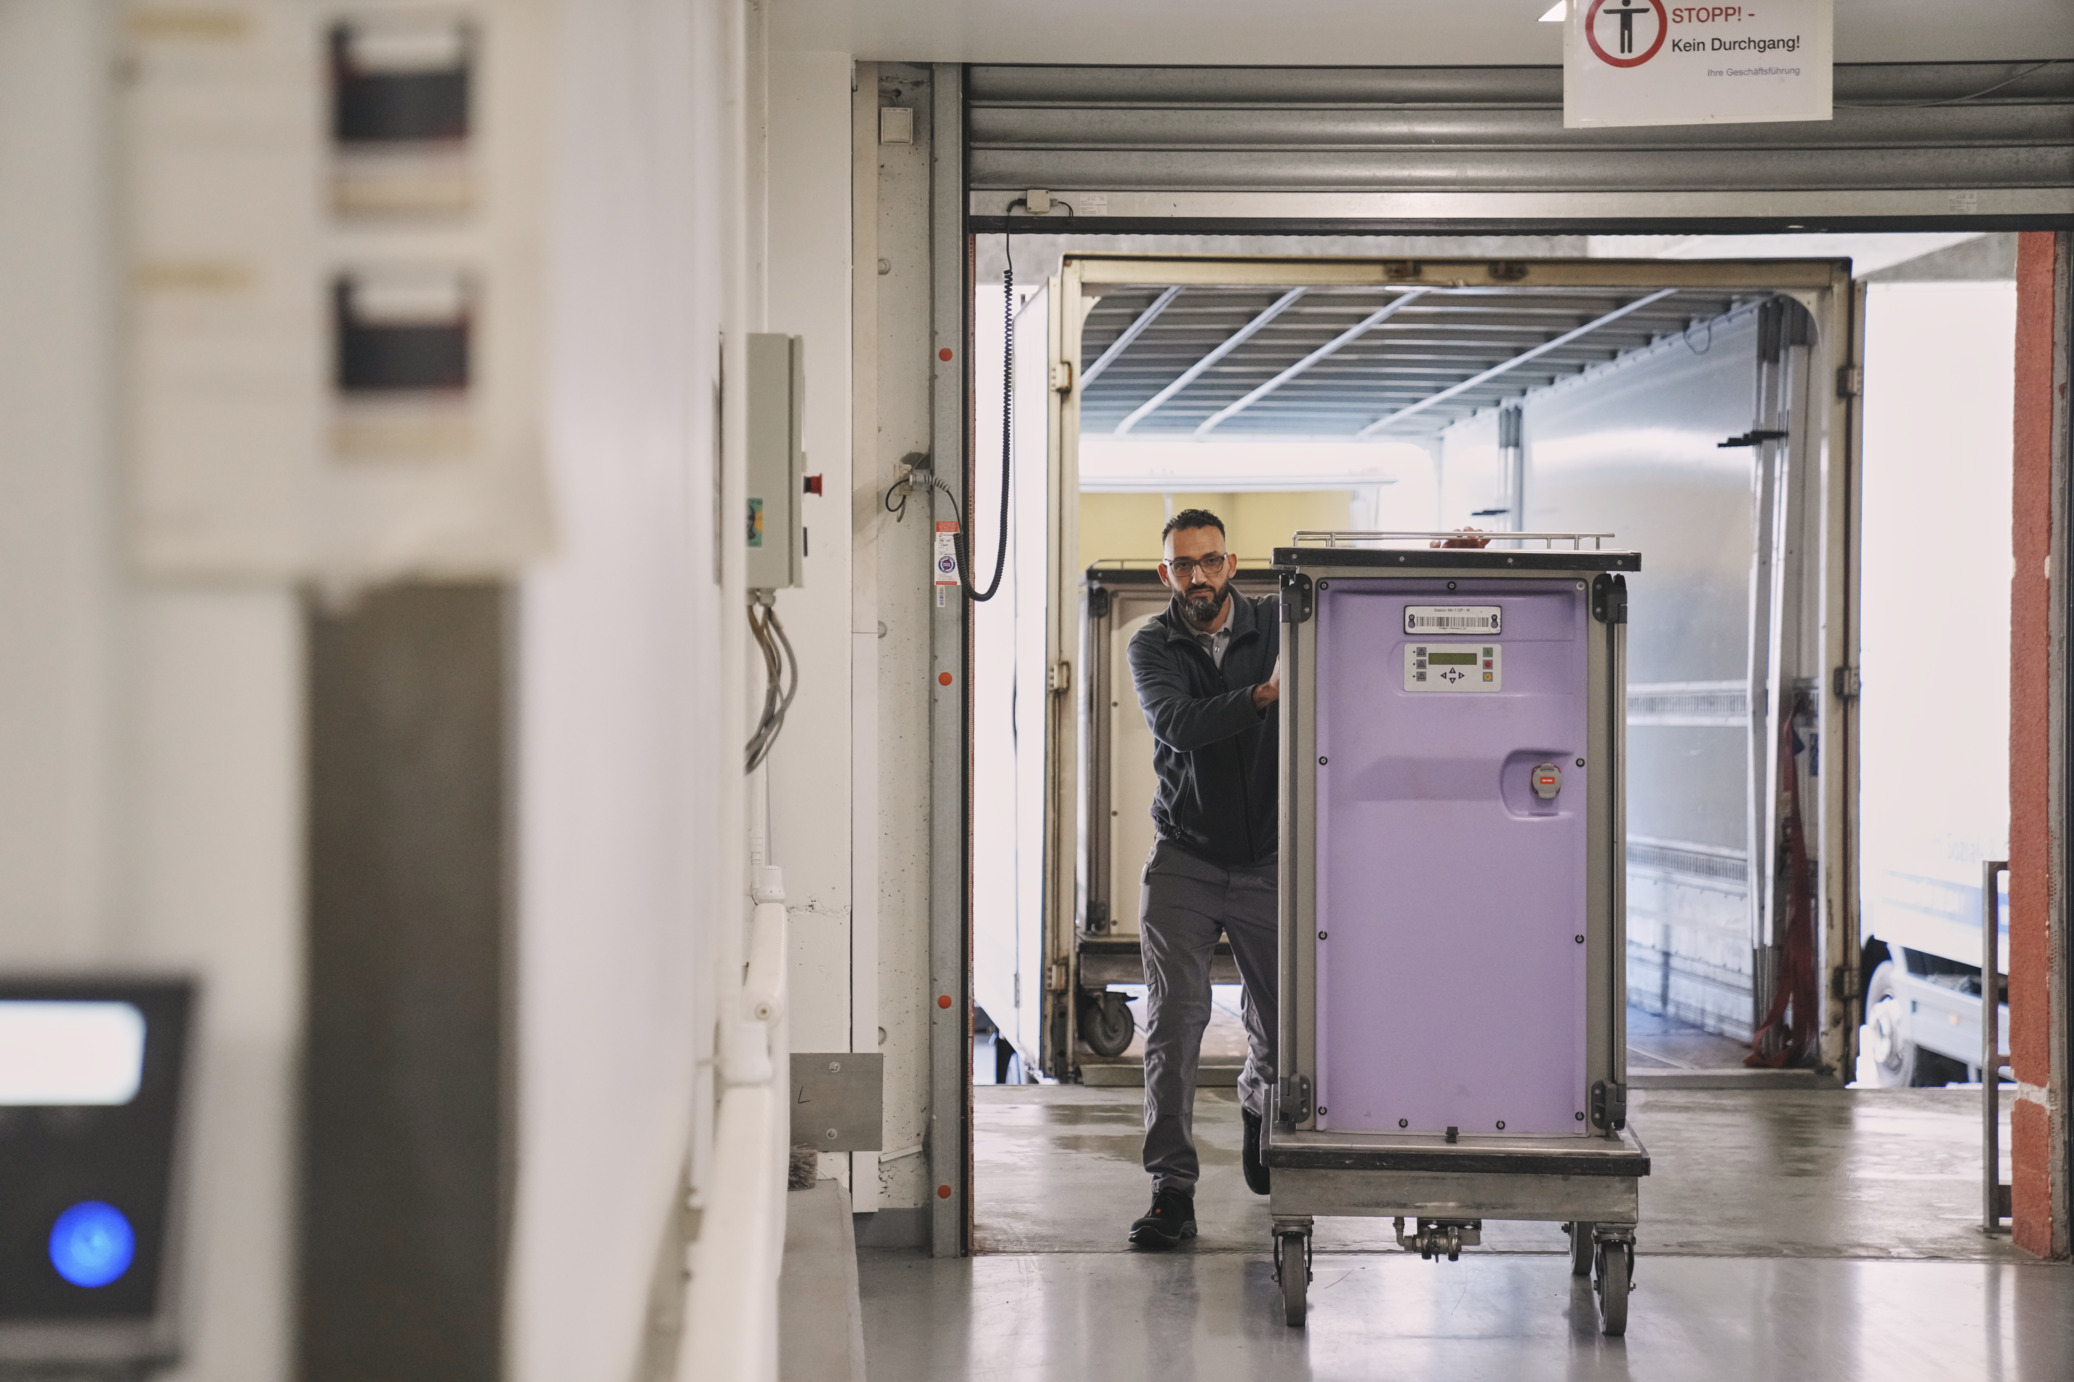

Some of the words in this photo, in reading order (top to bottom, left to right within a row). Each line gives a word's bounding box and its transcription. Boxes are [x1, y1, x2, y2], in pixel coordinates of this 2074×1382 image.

[1672, 6, 1742, 23] STOPP!
[1672, 38, 1706, 52] Kein
[1711, 35, 1800, 53] Durchgang!
[1707, 69, 1724, 77] Ihre
[1726, 67, 1800, 76] Geschäftsführung
